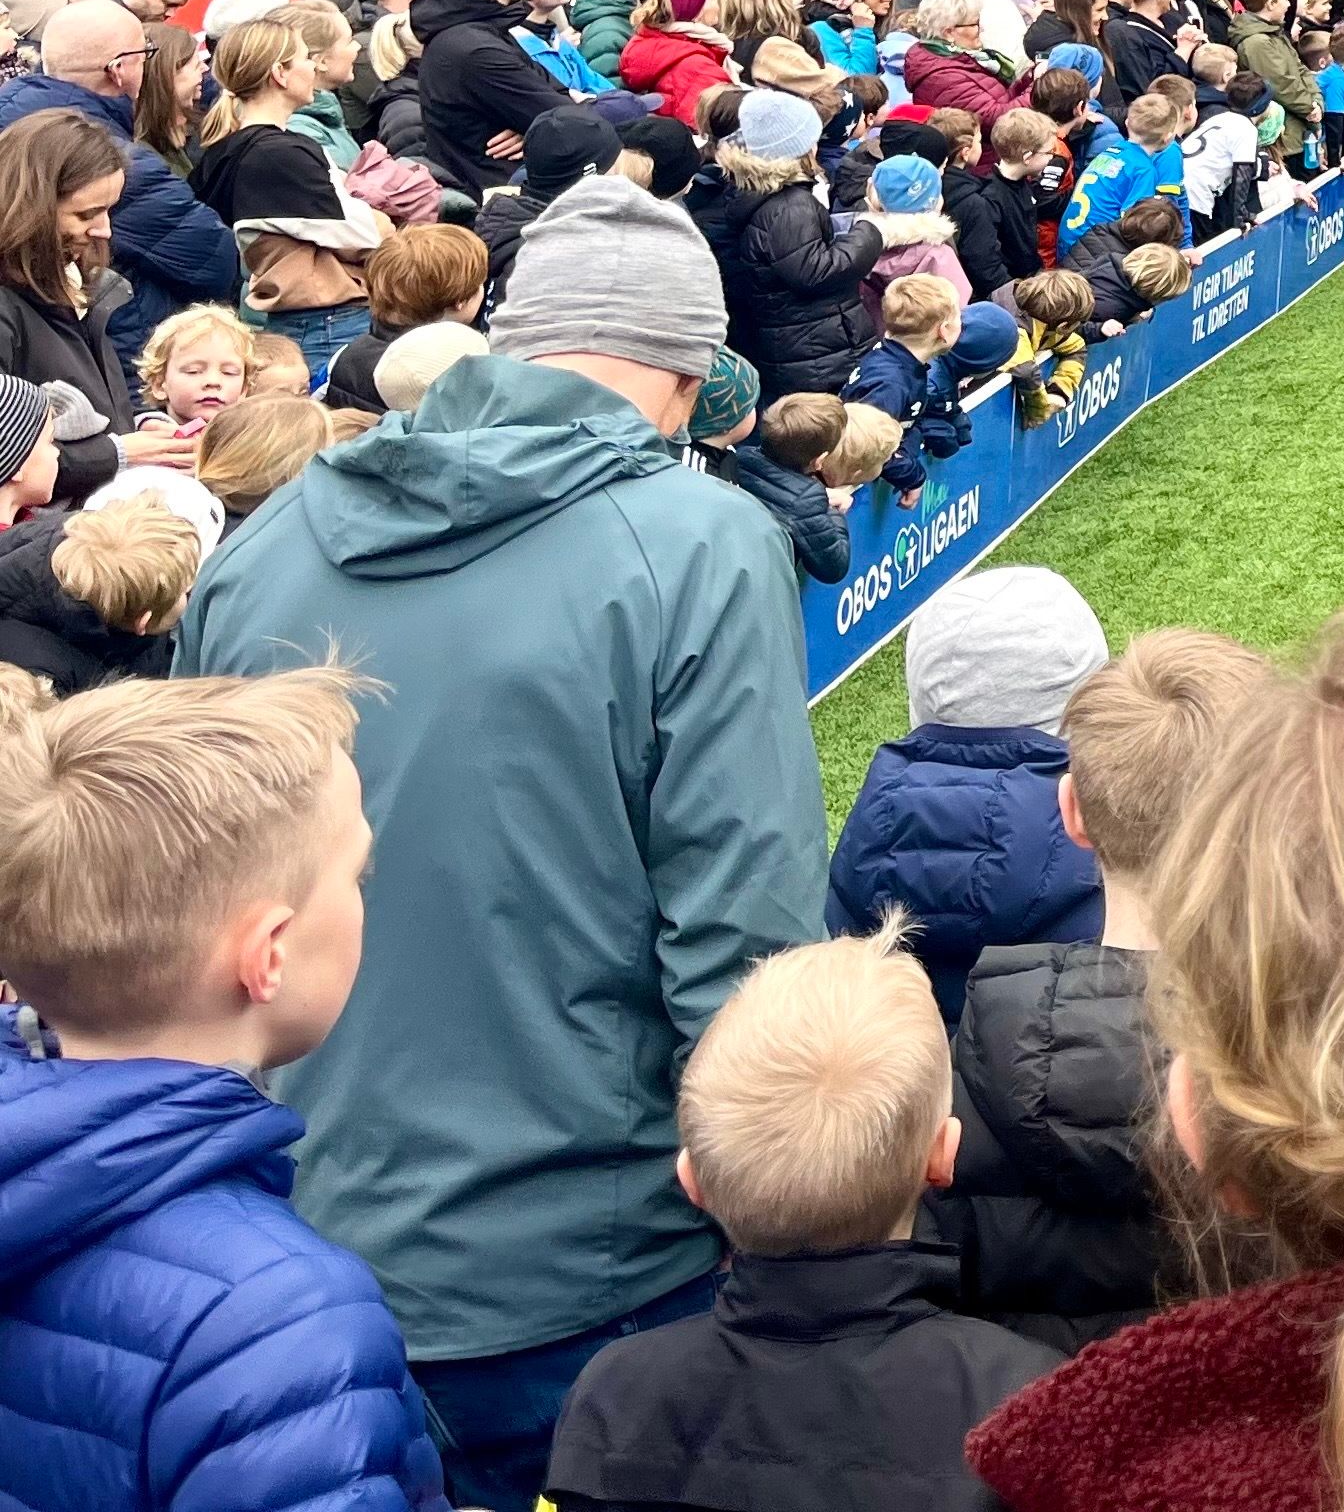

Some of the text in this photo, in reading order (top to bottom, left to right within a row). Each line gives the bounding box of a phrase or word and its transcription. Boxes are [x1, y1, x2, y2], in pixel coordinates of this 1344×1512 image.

[1066, 173, 1099, 230] 5
[1318, 207, 1344, 254] OBOS
[1192, 250, 1256, 310] VI GIR TILBAKE
[1192, 285, 1250, 344] TIL IDRETTEN
[1079, 356, 1122, 425] OBOS
[837, 554, 893, 635] OBOS
[921, 484, 980, 568] LIGAEN
